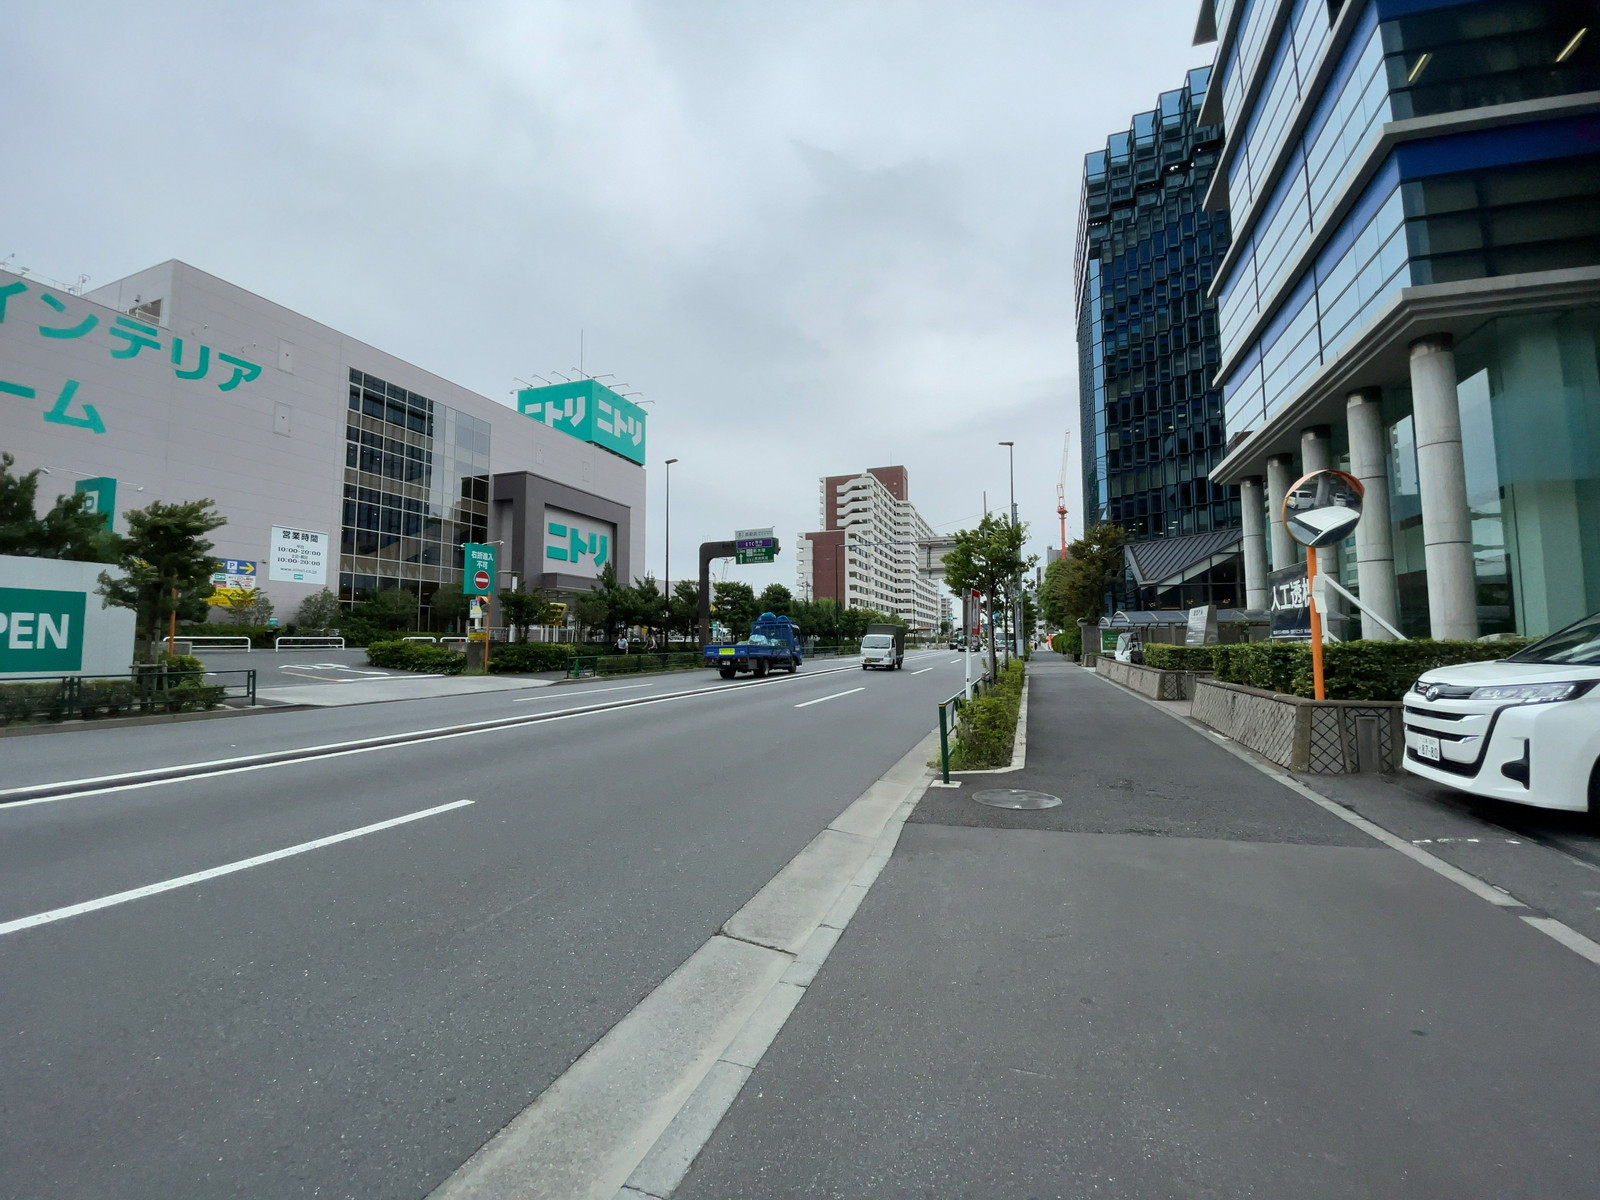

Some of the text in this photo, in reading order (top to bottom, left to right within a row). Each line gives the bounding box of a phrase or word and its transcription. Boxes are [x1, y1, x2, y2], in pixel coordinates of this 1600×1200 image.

[597, 400, 642, 447] ニトリ
[282, 530, 319, 543] 営業時間
[546, 522, 608, 567] ニトリ
[476, 560, 489, 569] 不可
